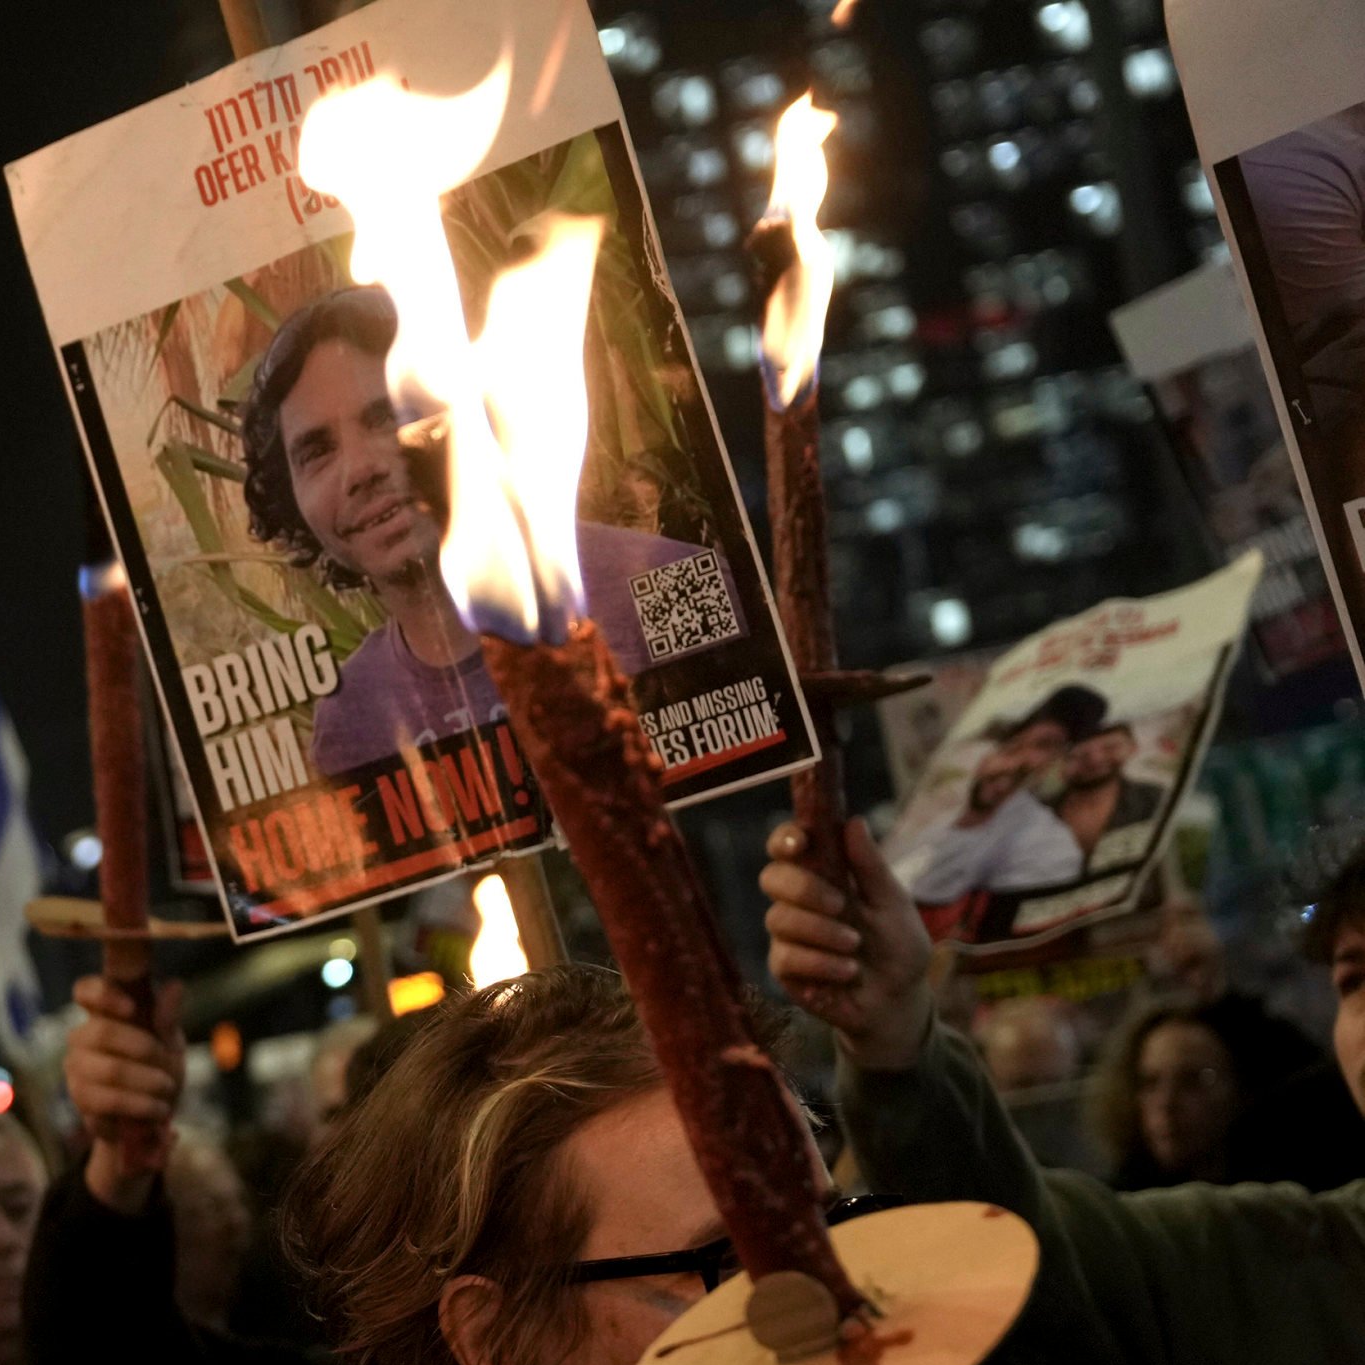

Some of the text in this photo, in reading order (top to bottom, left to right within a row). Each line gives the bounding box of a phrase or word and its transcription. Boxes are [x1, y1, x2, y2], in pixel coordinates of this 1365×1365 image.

[204, 73, 301, 154] קלדרון
[194, 143, 266, 208] OFER
[183, 624, 338, 736] BRING
[659, 701, 692, 732] AND
[691, 676, 767, 722] MISSING
[205, 717, 309, 812] HIM
[689, 700, 779, 760] FORUM
[229, 784, 379, 893] HOME
